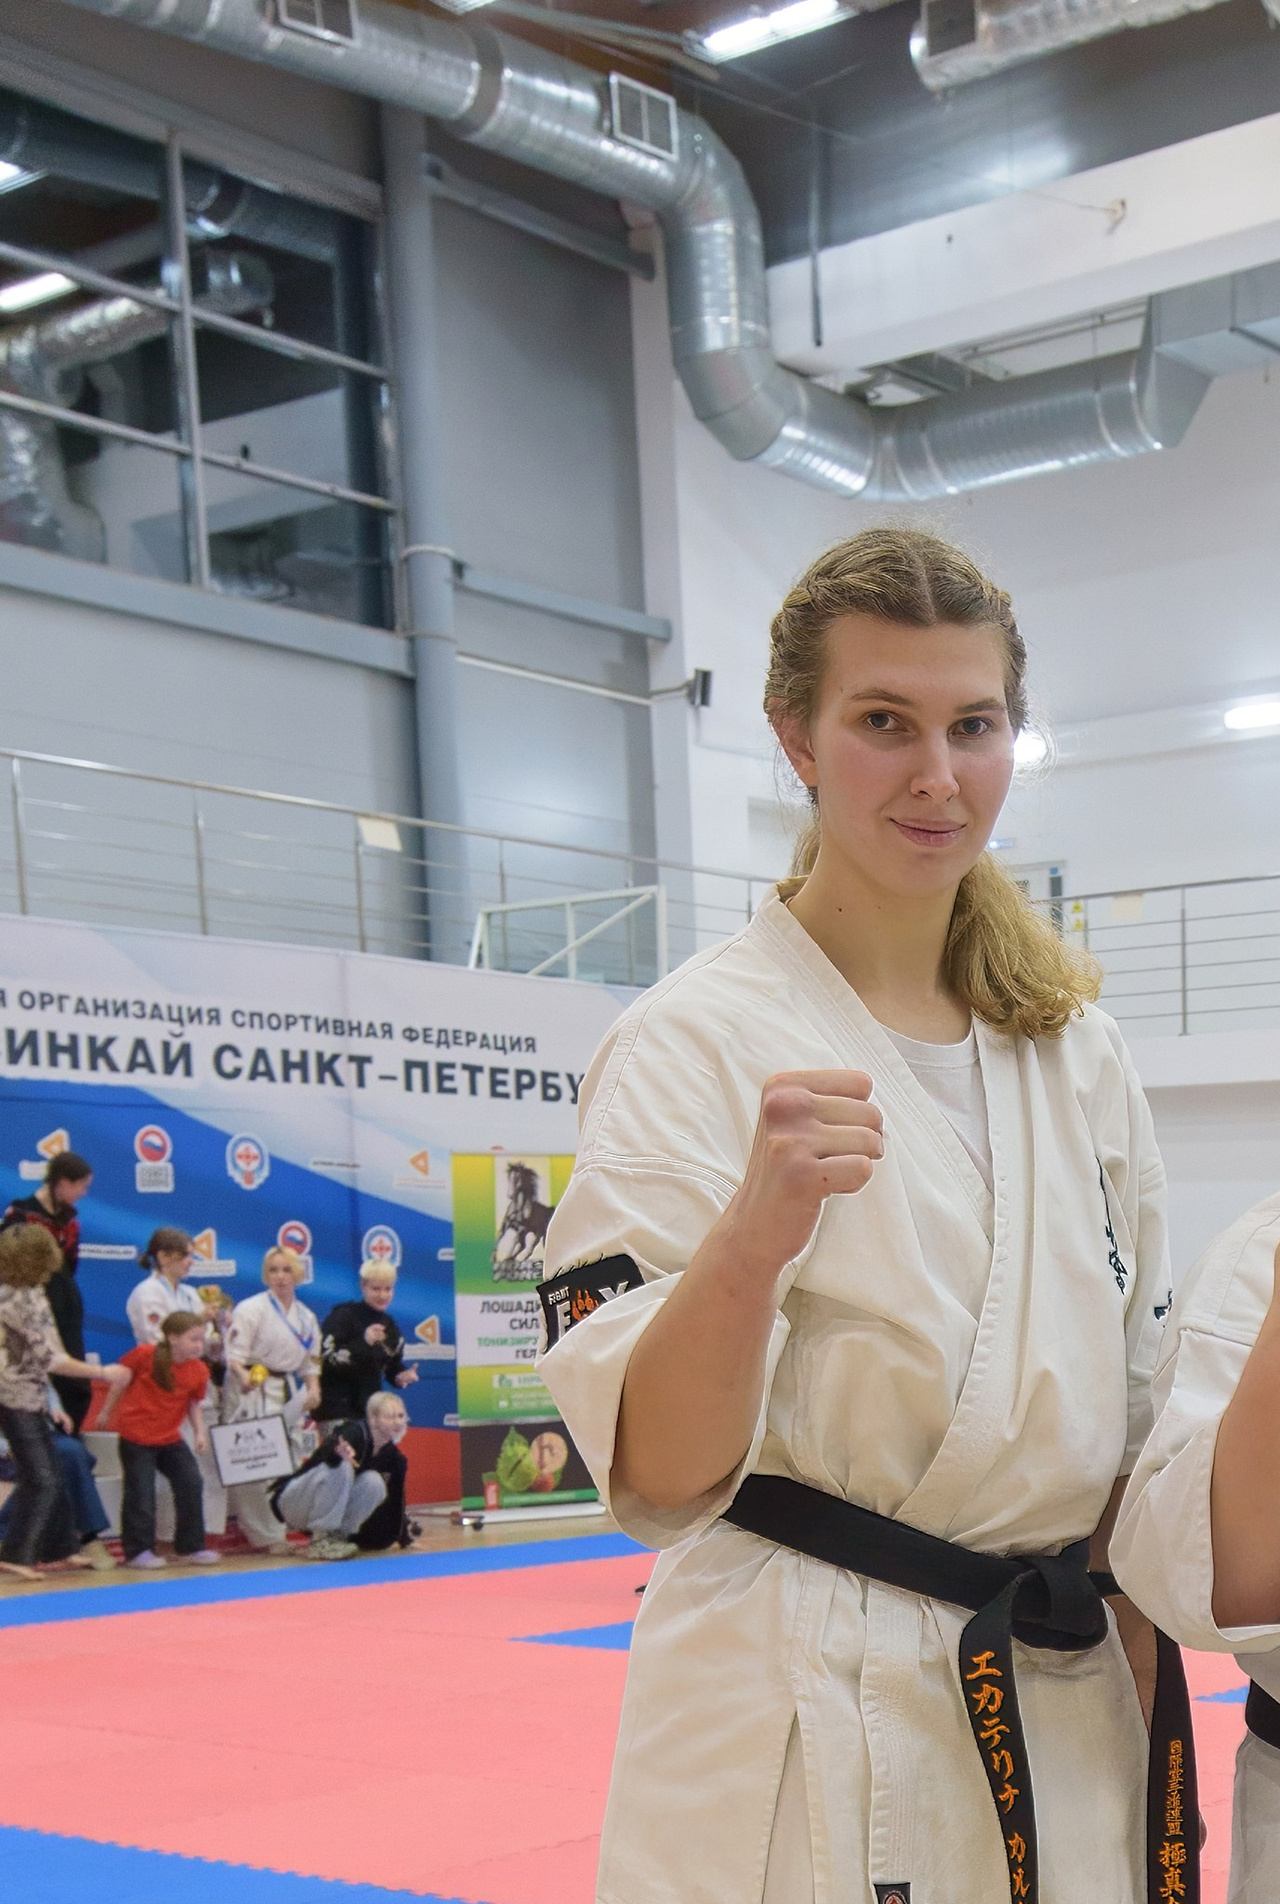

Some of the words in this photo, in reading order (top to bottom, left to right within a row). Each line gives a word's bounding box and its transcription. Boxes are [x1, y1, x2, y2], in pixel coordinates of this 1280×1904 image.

[18, 990, 221, 1027] ОРГАНИЗАЦИЯ
[231, 1009, 394, 1040] СПОРТИВНАЯ
[402, 1025, 537, 1055] ФЕДЕРАЦИЯ
